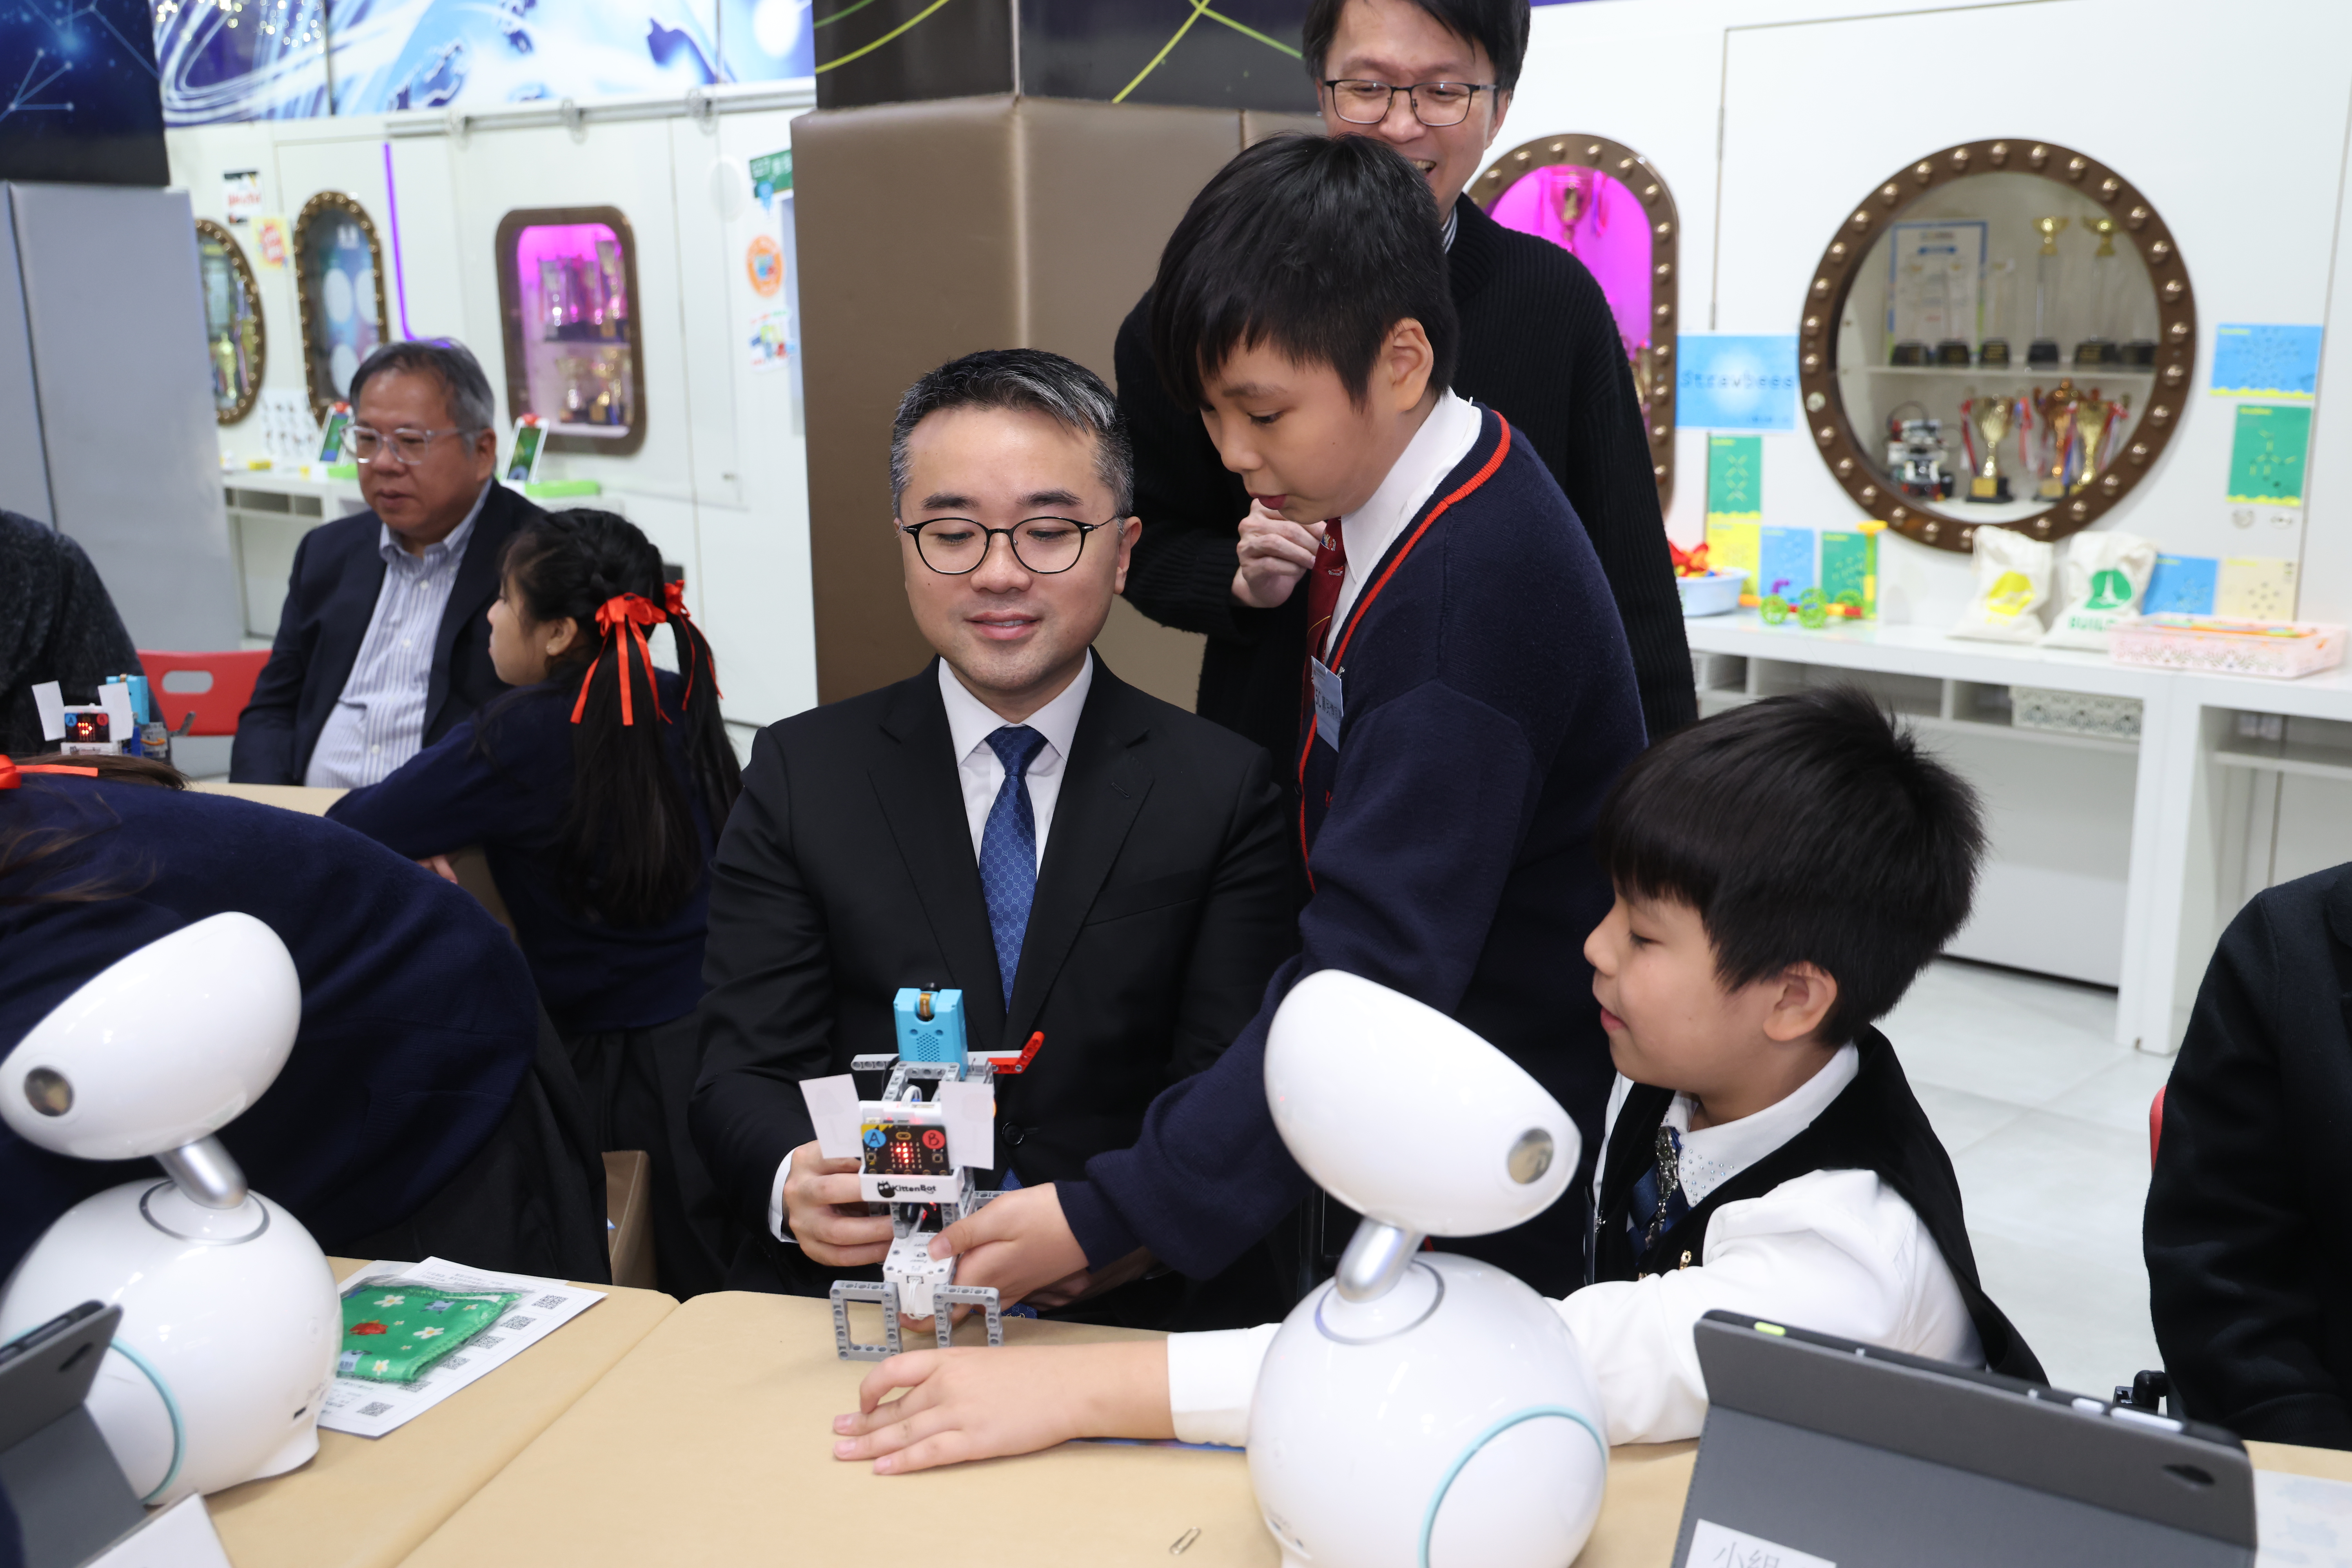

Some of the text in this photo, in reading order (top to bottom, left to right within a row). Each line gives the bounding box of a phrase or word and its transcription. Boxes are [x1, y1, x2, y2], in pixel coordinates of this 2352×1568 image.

[1315, 688, 1321, 708] 5C
[868, 1131, 880, 1145] A
[928, 1132, 939, 1146] B
[893, 1185, 936, 1194] KittenBot
